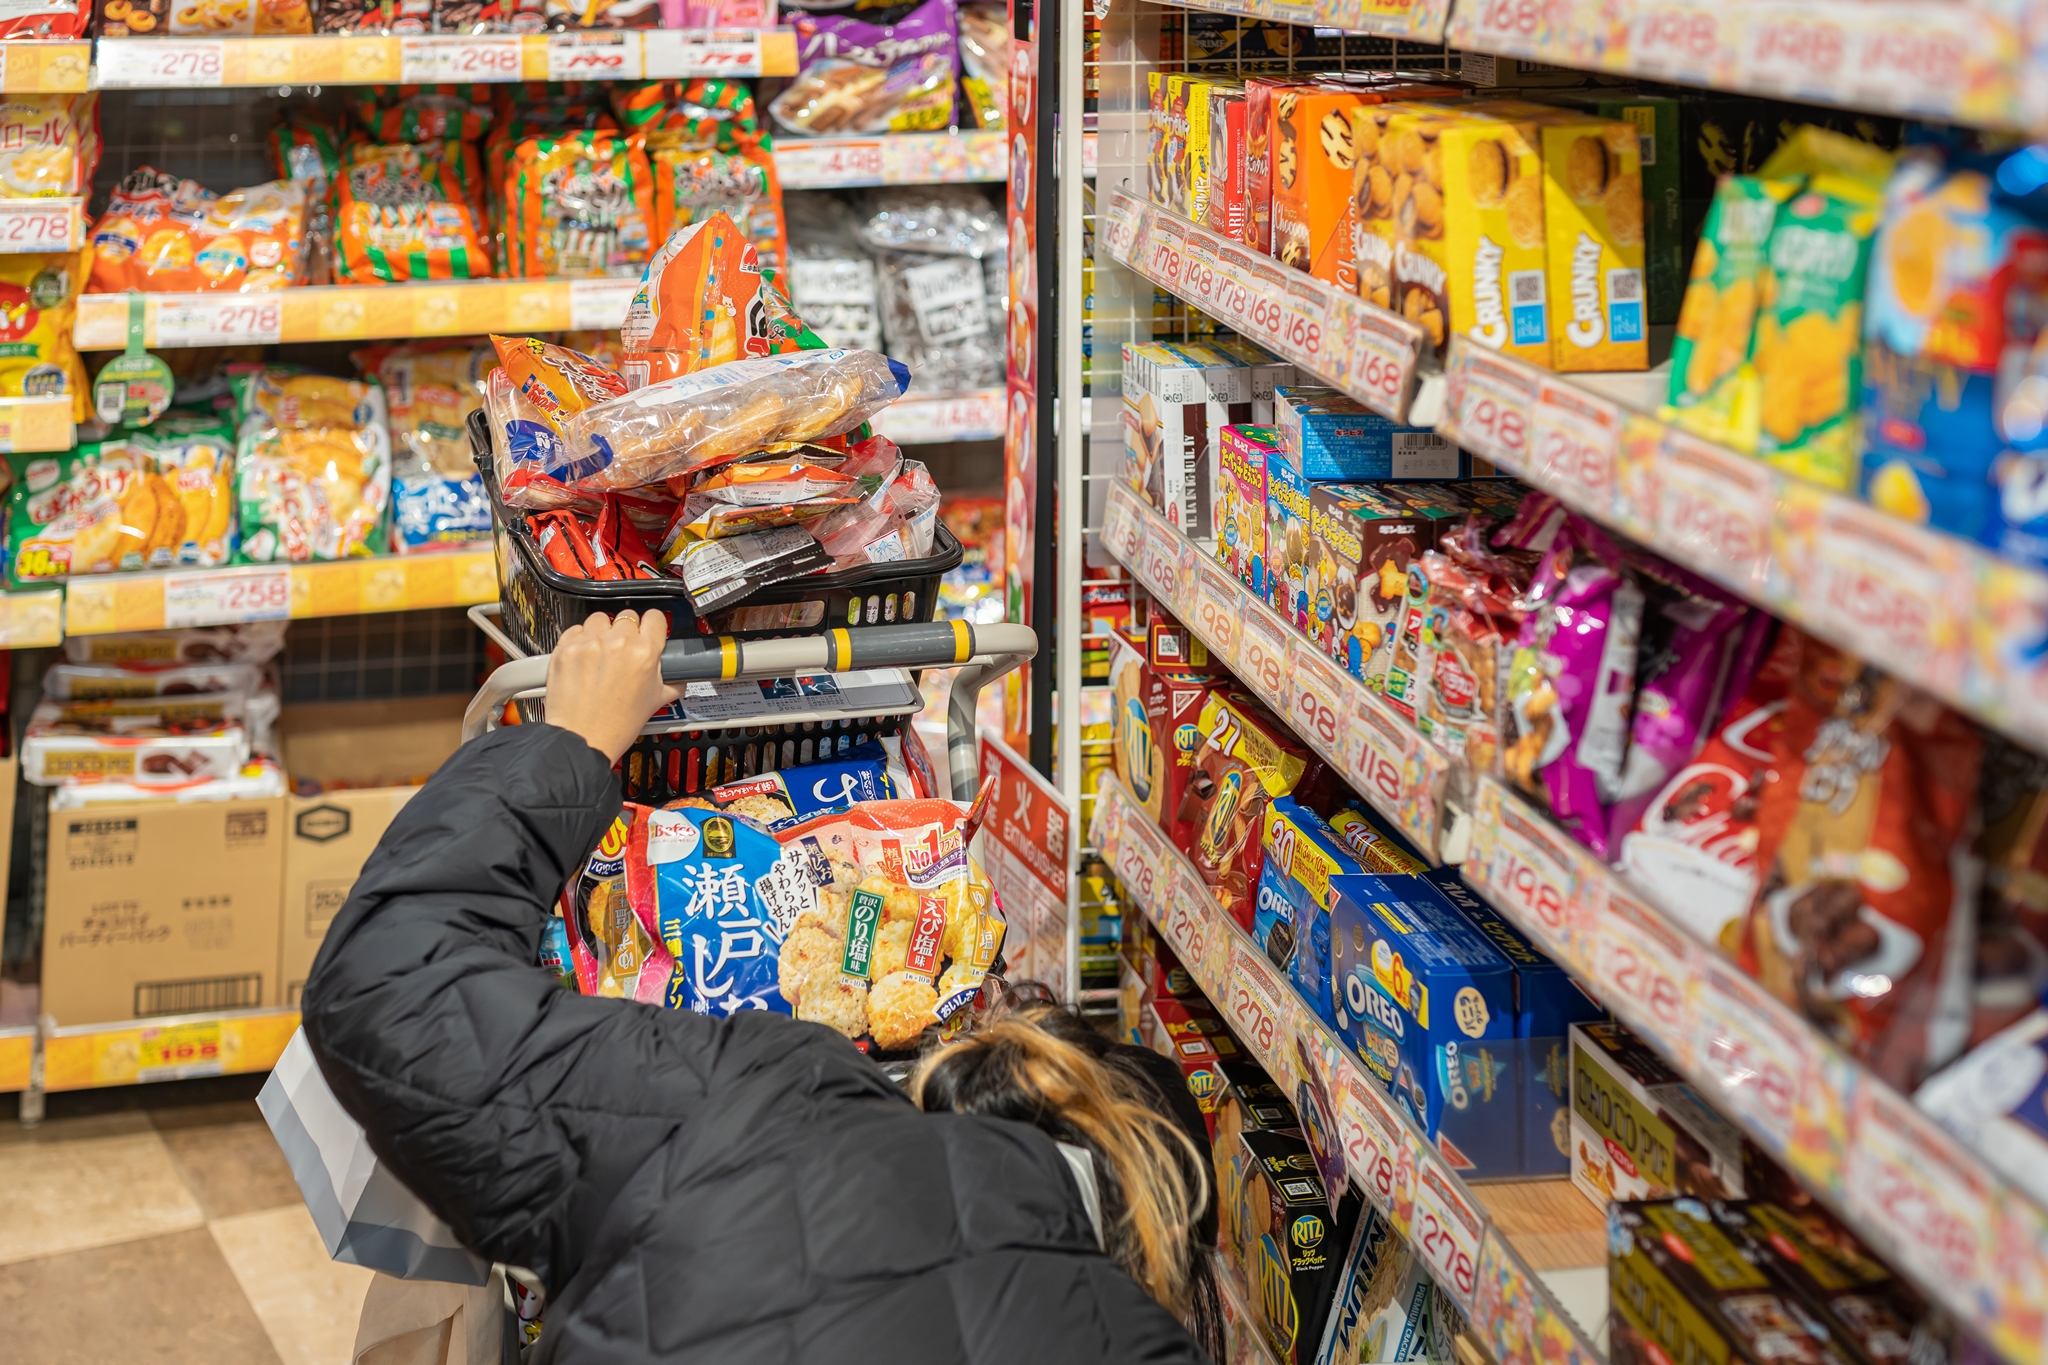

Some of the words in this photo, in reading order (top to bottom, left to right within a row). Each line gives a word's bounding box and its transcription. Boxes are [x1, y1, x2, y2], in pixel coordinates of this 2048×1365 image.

[162, 52, 221, 75] 278
[453, 49, 519, 71] 298
[7, 216, 69, 241] 278
[1154, 243, 1180, 278] 178
[1185, 259, 1213, 295] 198
[1216, 276, 1247, 314] 178
[1566, 230, 1606, 348] CRUNKY
[220, 306, 279, 332] 278
[1249, 293, 1282, 333] 168
[1286, 312, 1322, 354] 168
[1357, 350, 1401, 396] 168
[1110, 518, 1138, 558] 168
[228, 580, 288, 610] 258
[1148, 551, 1176, 594] 168
[1202, 602, 1232, 646] 98
[1249, 644, 1282, 692] 98
[1175, 728, 1198, 750] RIT
[1207, 705, 1244, 758] 27
[1300, 691, 1337, 743] 98
[1359, 742, 1400, 801] 118
[1002, 818, 1067, 894] EXTINGUISHER
[1123, 846, 1154, 896] 278
[1270, 818, 1297, 882] 30
[1258, 885, 1295, 925] OREO
[1501, 856, 1563, 928] 198
[914, 899, 943, 968] えび塩味
[1174, 910, 1204, 964] 278
[1235, 988, 1274, 1051] 278
[1346, 973, 1405, 1039] OREO
[1445, 1041, 1469, 1110] OREO
[1576, 1066, 1638, 1154] CHOCO
[1348, 1122, 1394, 1197] 278
[1293, 1219, 1323, 1246] RITZ
[1422, 1213, 1474, 1296] 278
[1291, 1255, 1328, 1266] ブラックペッパー
[1257, 1237, 1296, 1340] RITZ
[1407, 1285, 1427, 1329] PREMIUM
